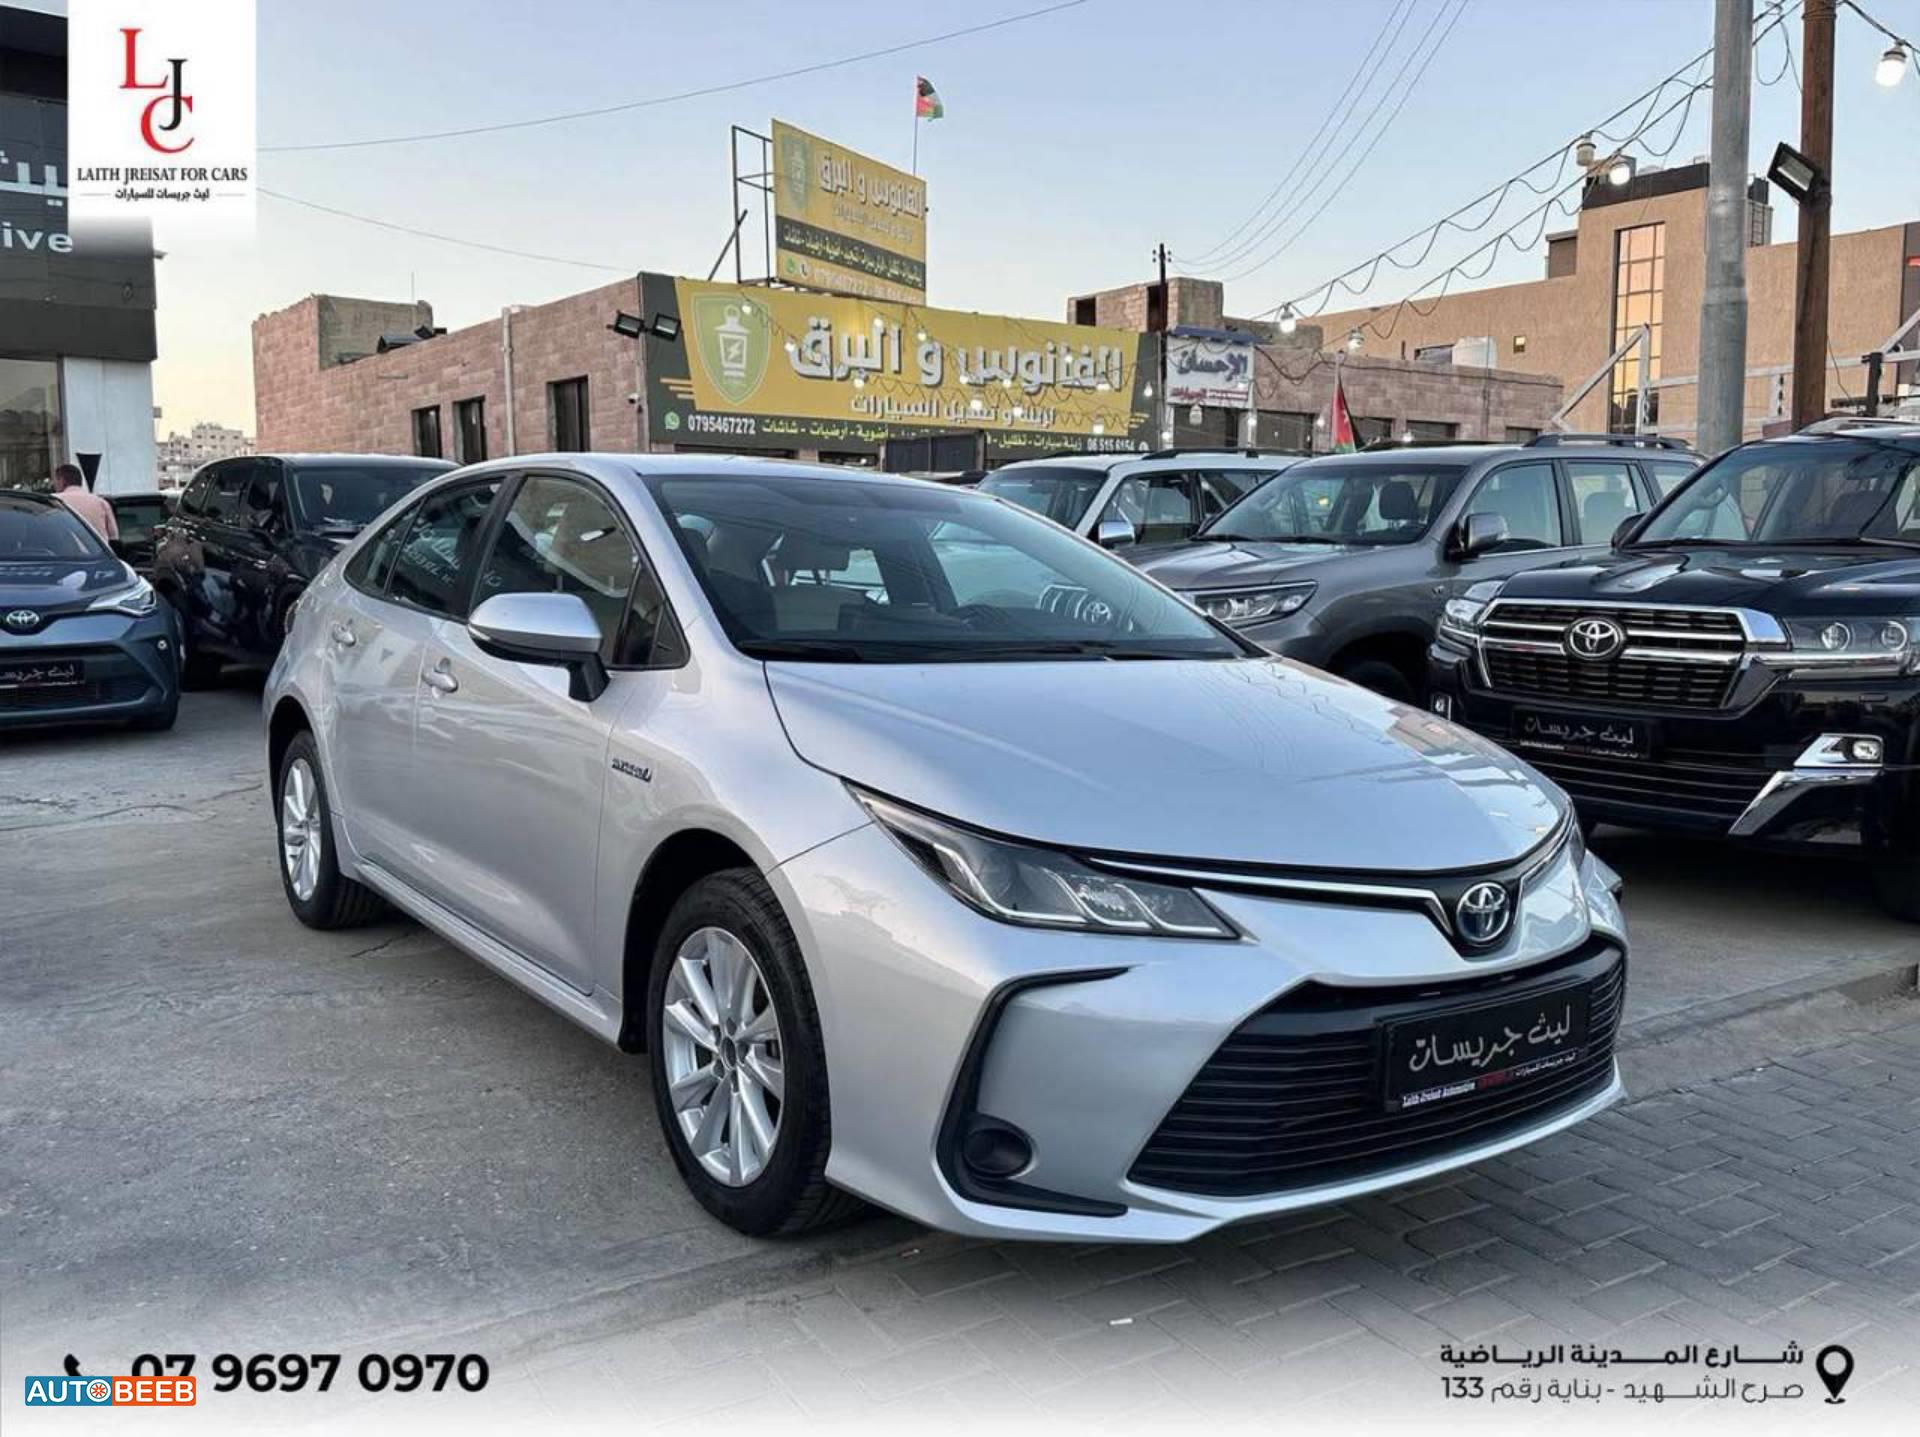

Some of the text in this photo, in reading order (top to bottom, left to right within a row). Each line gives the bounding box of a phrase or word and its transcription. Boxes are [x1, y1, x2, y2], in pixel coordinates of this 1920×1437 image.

[785, 316, 1123, 396] الفانوس و البرق
[687, 414, 757, 435] 0795467272
[851, 395, 940, 421] السيارات
[1527, 1004, 1571, 1045] ليث
[1409, 1026, 1523, 1072] جريسات
